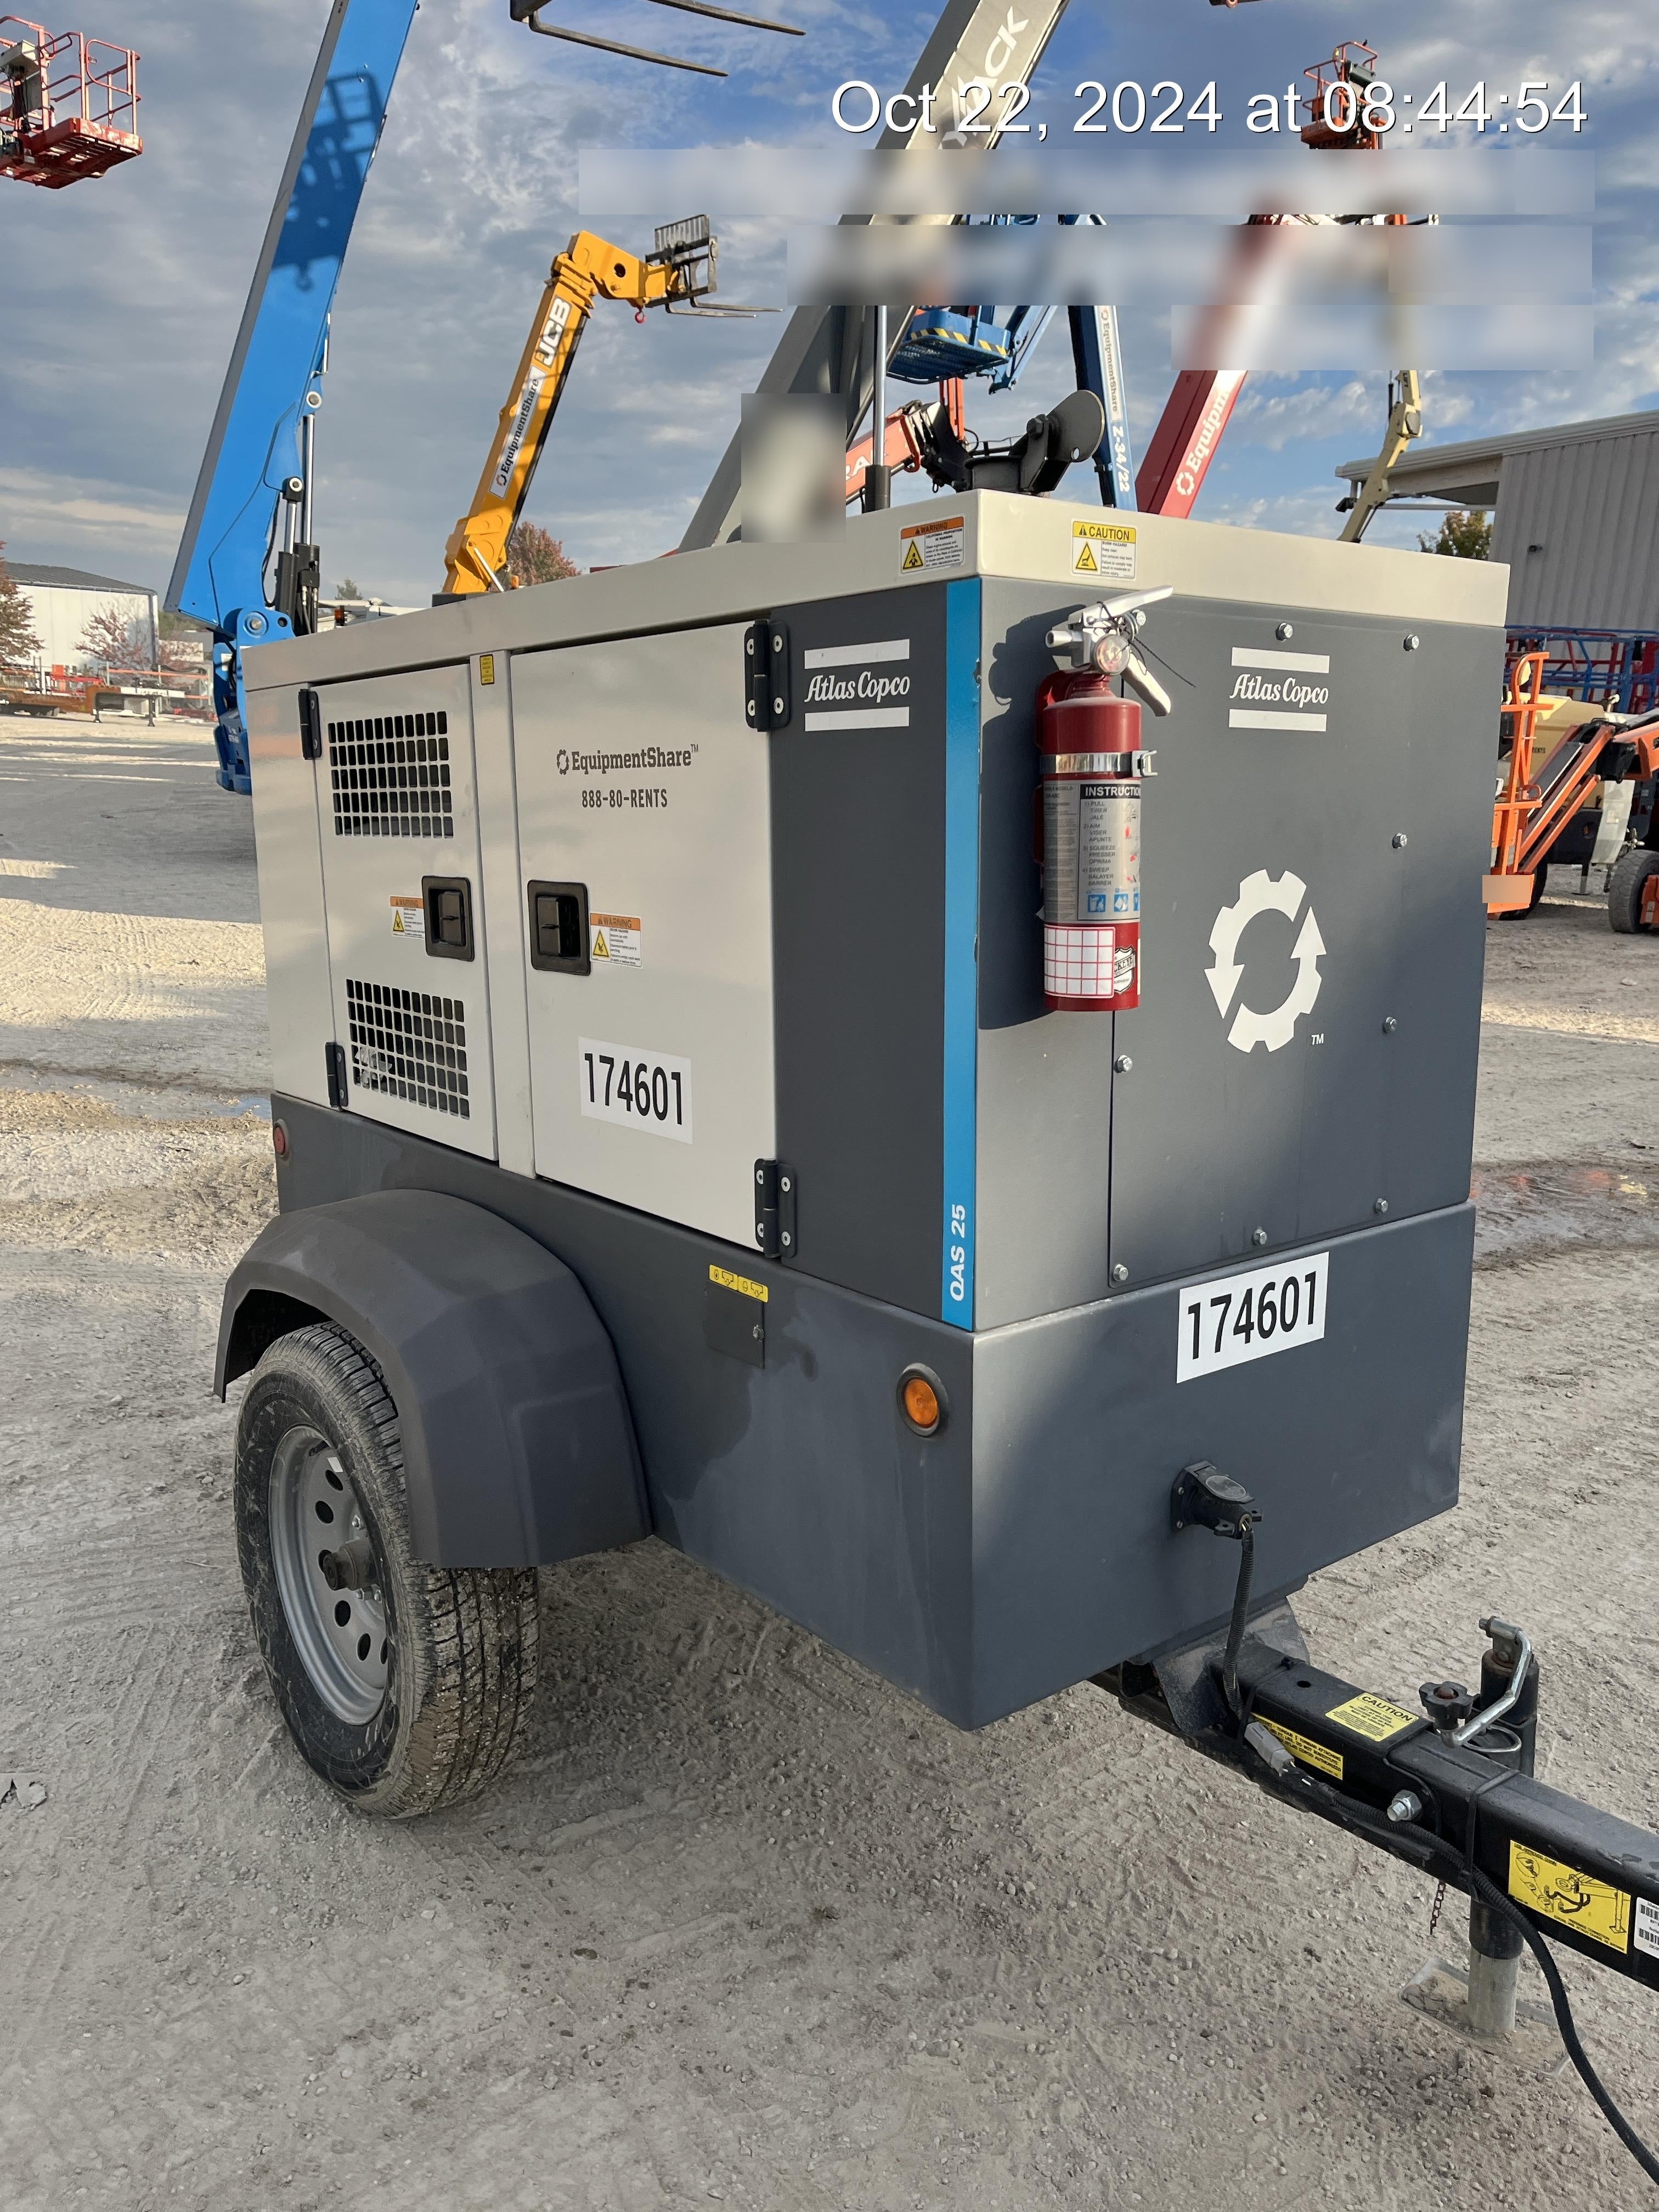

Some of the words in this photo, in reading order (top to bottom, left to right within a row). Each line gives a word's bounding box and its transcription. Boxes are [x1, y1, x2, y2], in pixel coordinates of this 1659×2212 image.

[538, 297, 571, 366] JCB
[1103, 324, 1118, 413] EquipmentShare
[500, 379, 540, 474] EquipmentShare
[1113, 425, 1131, 493] Z-34/22
[921, 522, 948, 533] WARNING
[1089, 526, 1130, 541] CAUTION
[582, 788, 668, 808] 888-80-RENTS
[603, 917, 632, 928] WARNING
[1311, 1033, 1324, 1045] TM
[584, 1053, 682, 1125] 174601
[951, 1204, 966, 1238] 25
[950, 1245, 965, 1301] QAS
[1187, 1271, 1317, 1360] 174601
[1362, 1696, 1413, 1722] CAUTION
